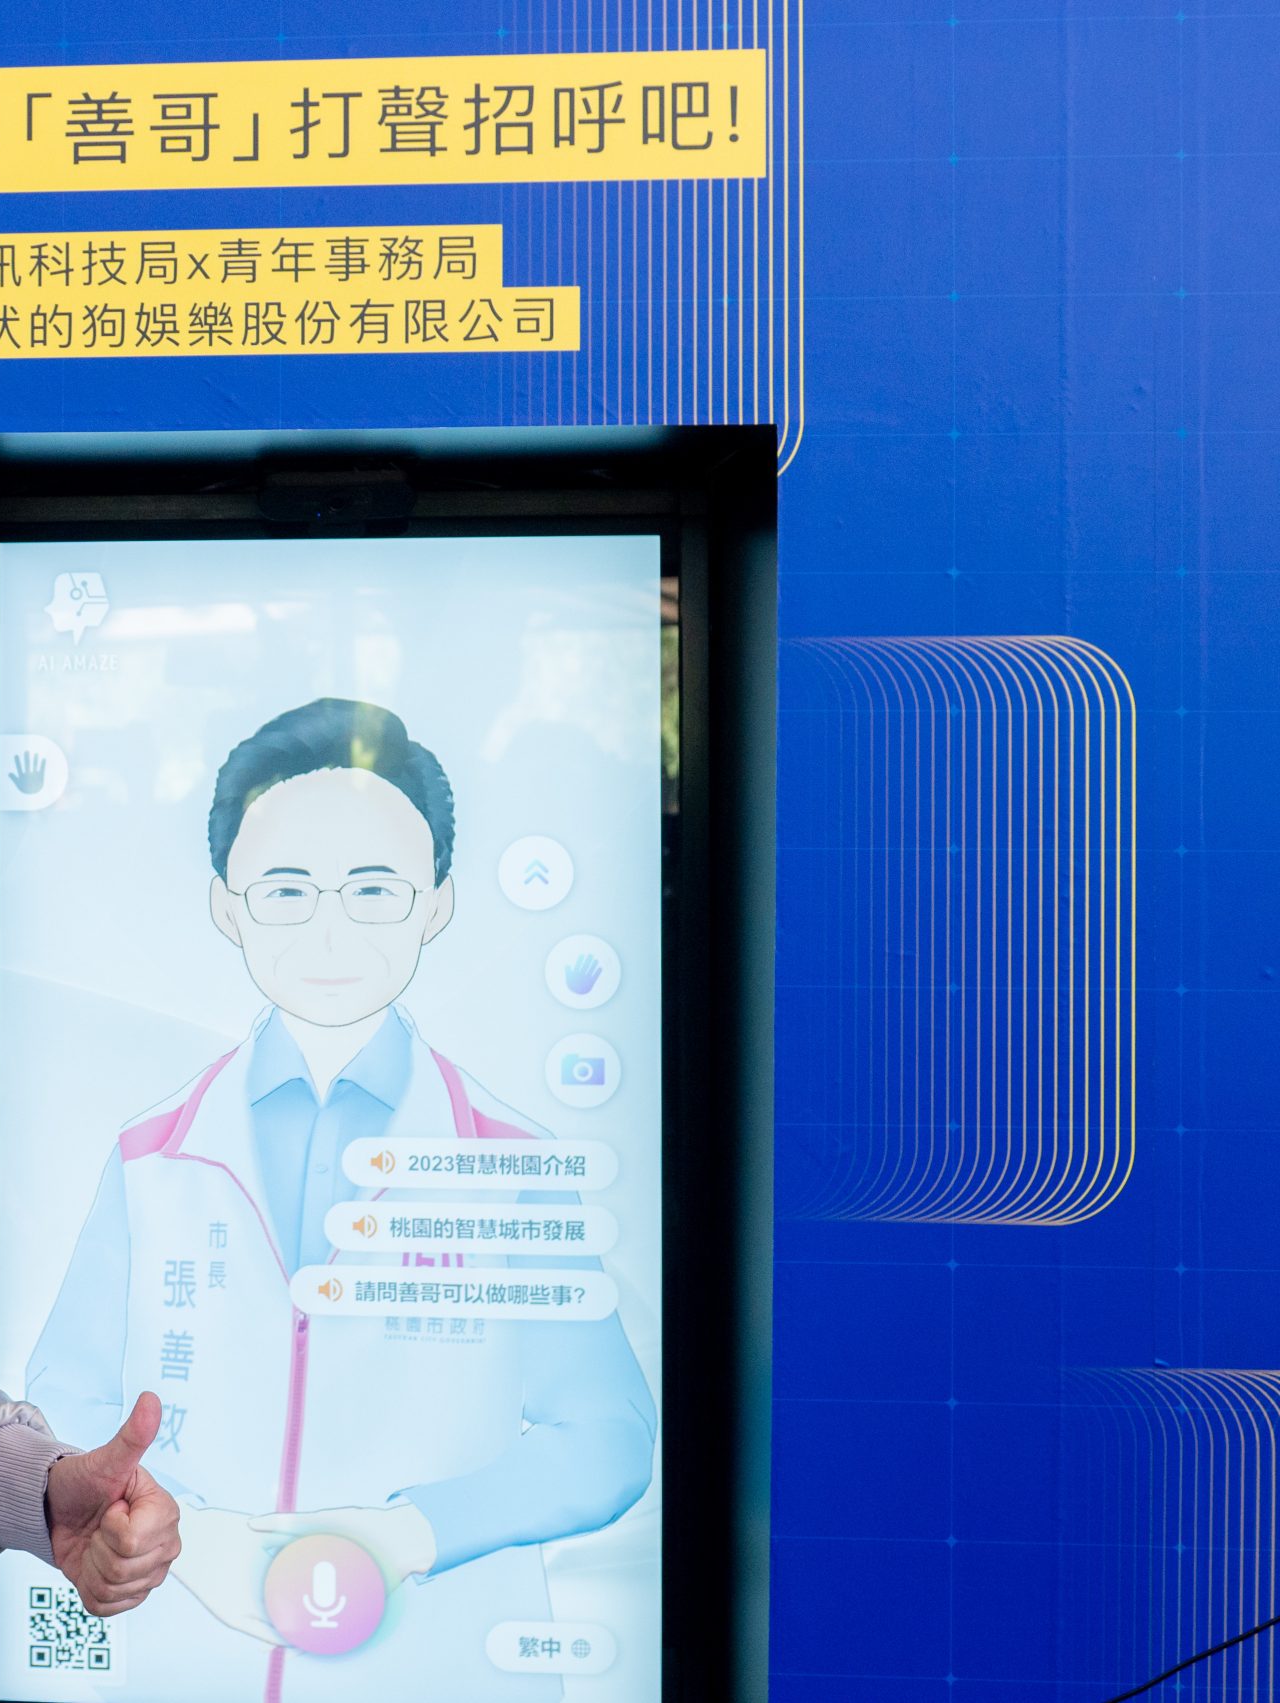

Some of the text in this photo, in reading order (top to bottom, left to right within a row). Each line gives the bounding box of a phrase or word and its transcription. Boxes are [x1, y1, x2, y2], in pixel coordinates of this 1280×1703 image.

[408, 1154, 586, 1177] 2023智慧桃園介紹
[389, 1216, 586, 1242] 桃園的智慧城市發展
[207, 1219, 229, 1290] 市長
[354, 1280, 586, 1306] 請問善哥可以做哪些事?
[518, 1636, 561, 1658] 繁中
